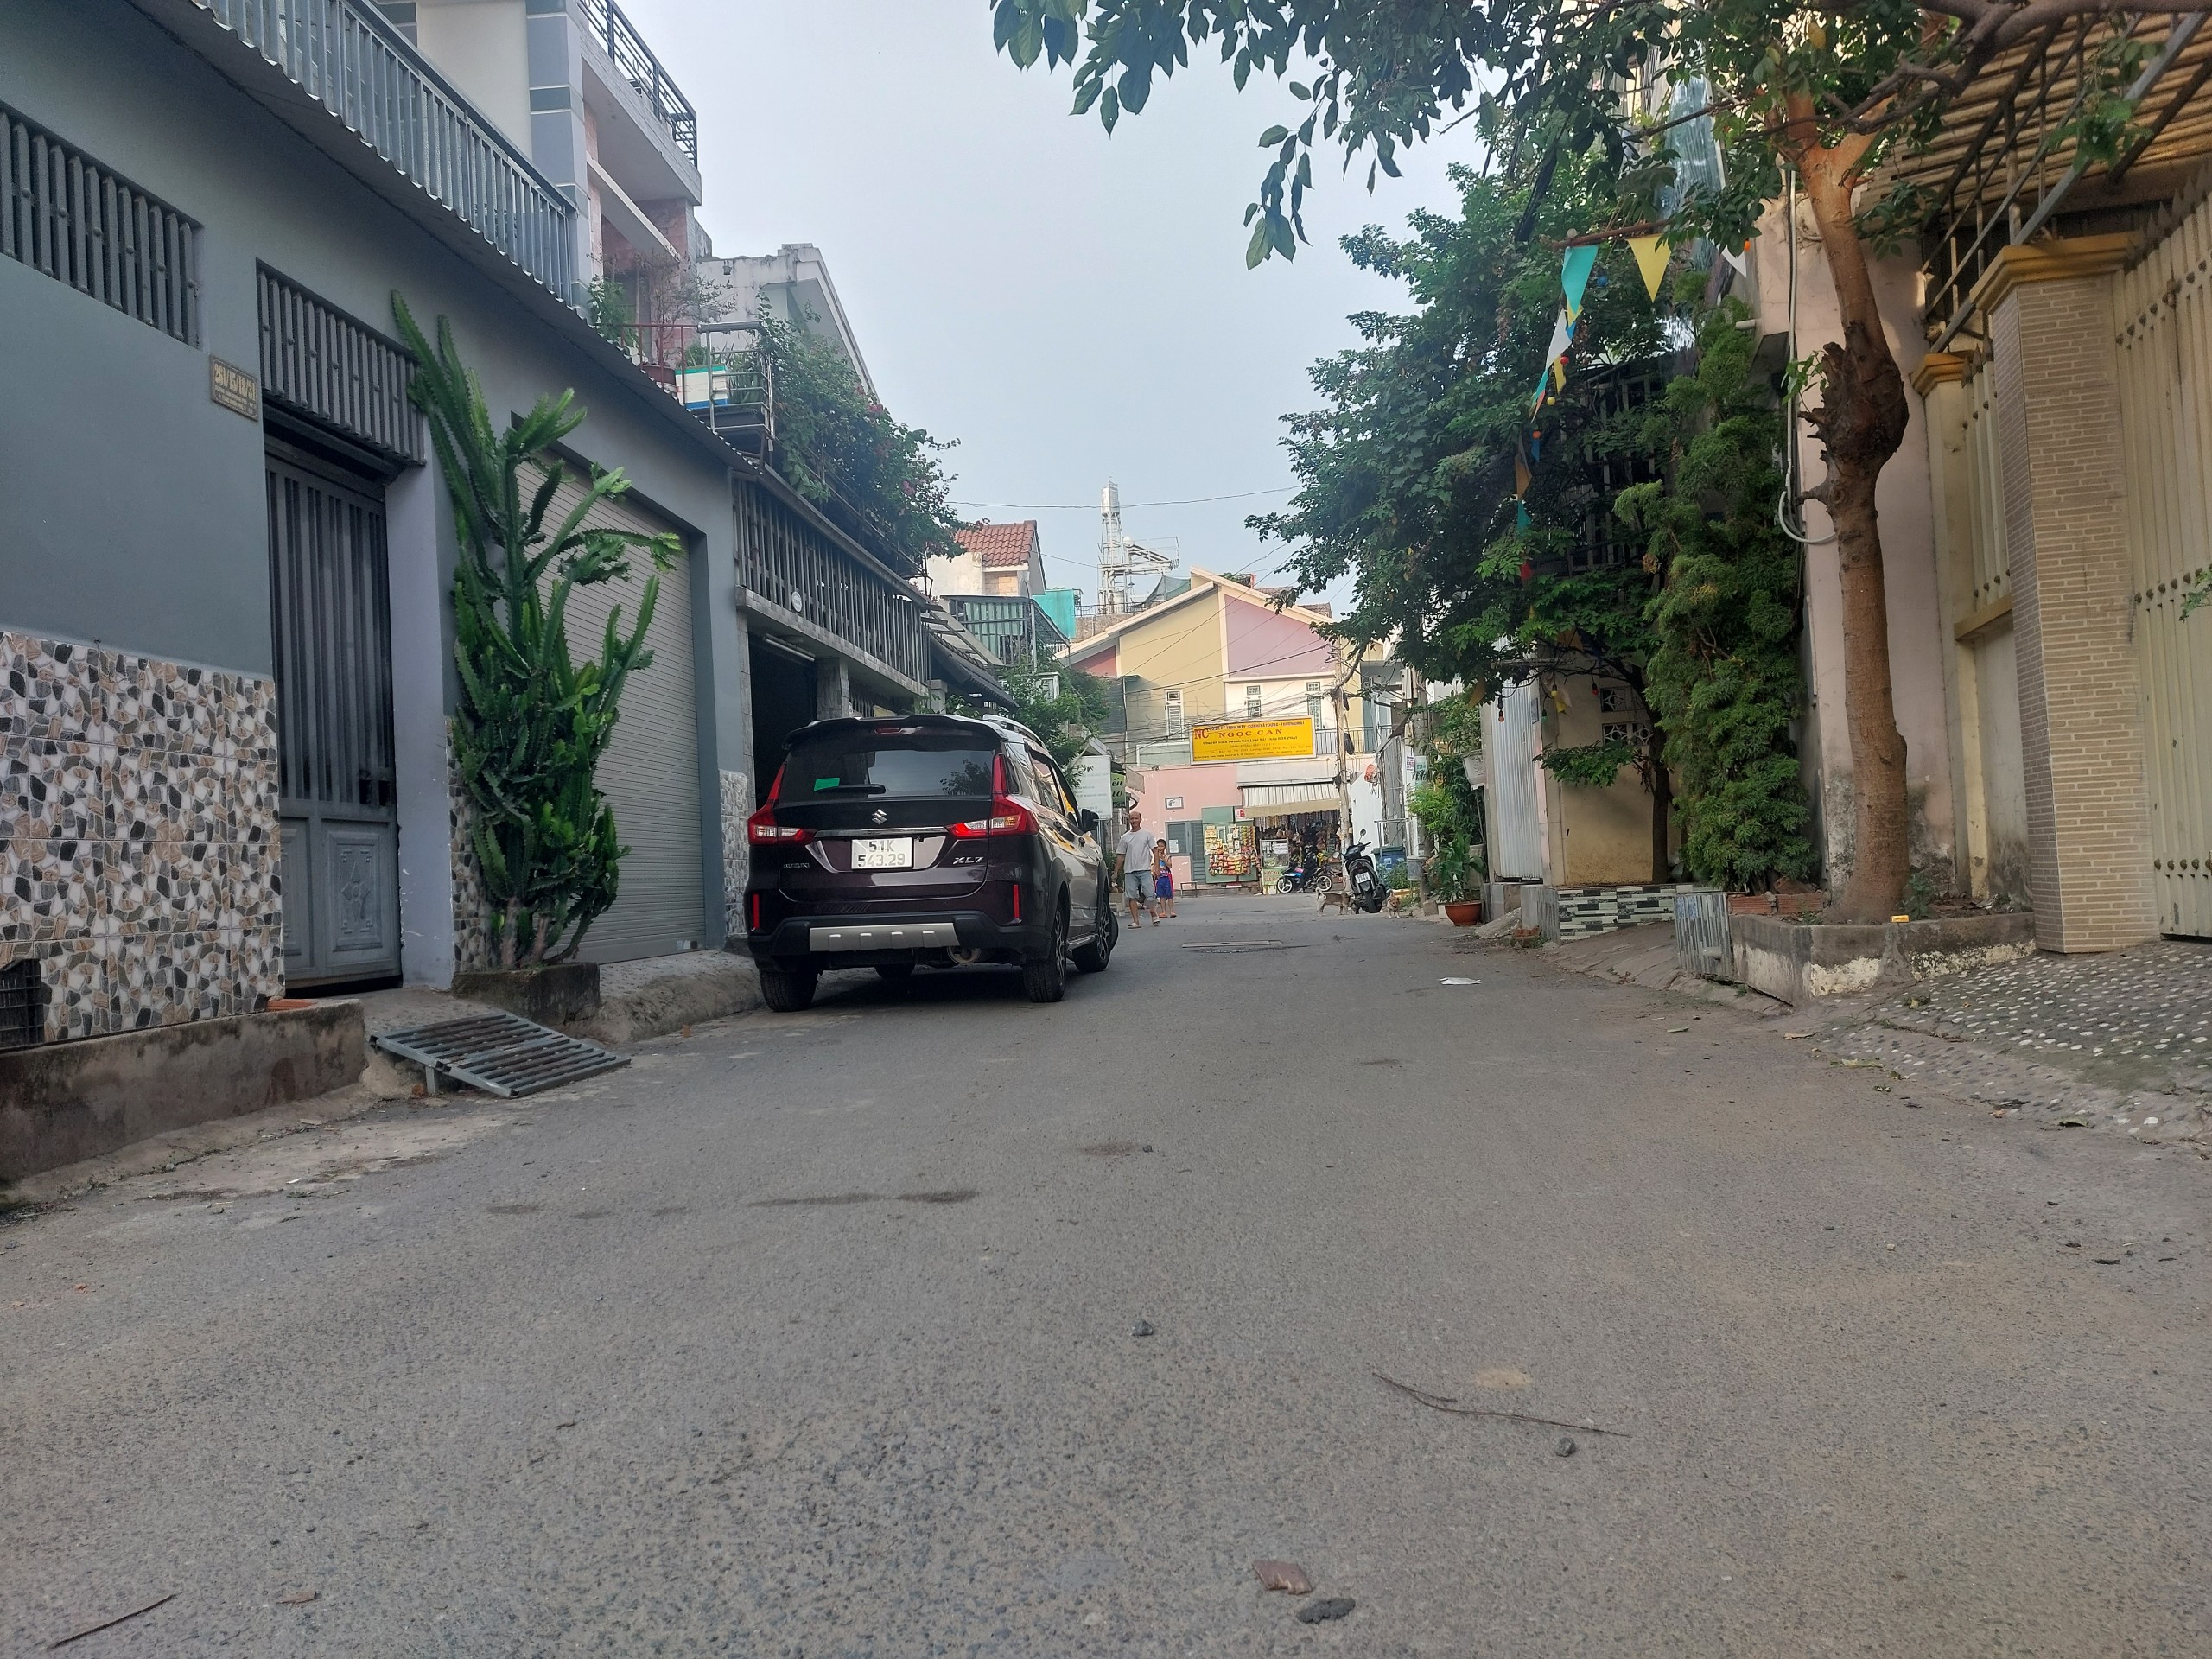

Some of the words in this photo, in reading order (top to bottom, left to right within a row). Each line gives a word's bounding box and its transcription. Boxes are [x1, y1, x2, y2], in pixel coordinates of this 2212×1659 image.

[868, 839, 894, 853] 51K
[858, 853, 906, 867] 543.29
[952, 856, 984, 865] XL7
